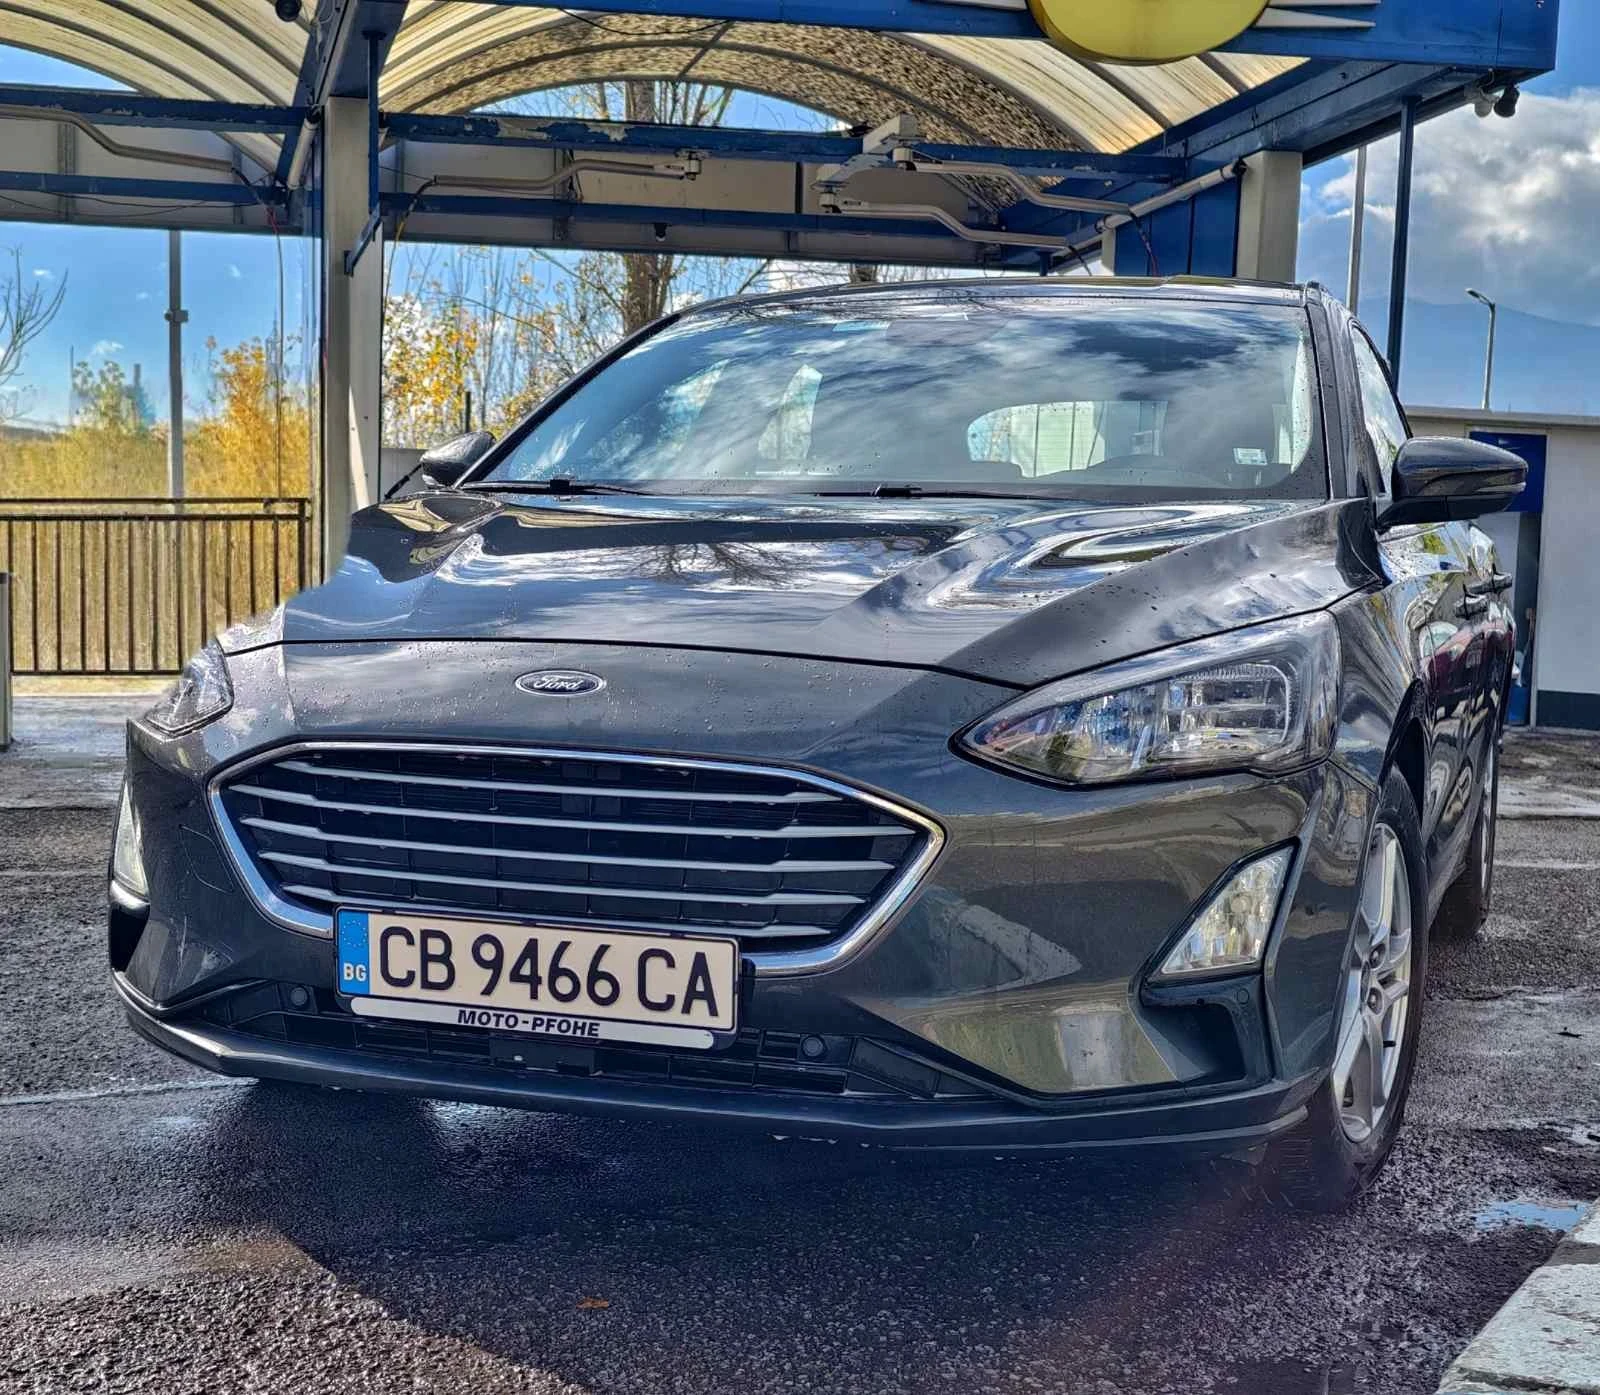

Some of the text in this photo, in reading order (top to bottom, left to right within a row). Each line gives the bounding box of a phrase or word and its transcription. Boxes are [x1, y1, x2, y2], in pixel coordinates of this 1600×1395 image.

[533, 674, 584, 690] Ford
[343, 962, 367, 982] BG
[379, 925, 719, 1017] CB 9466 CA
